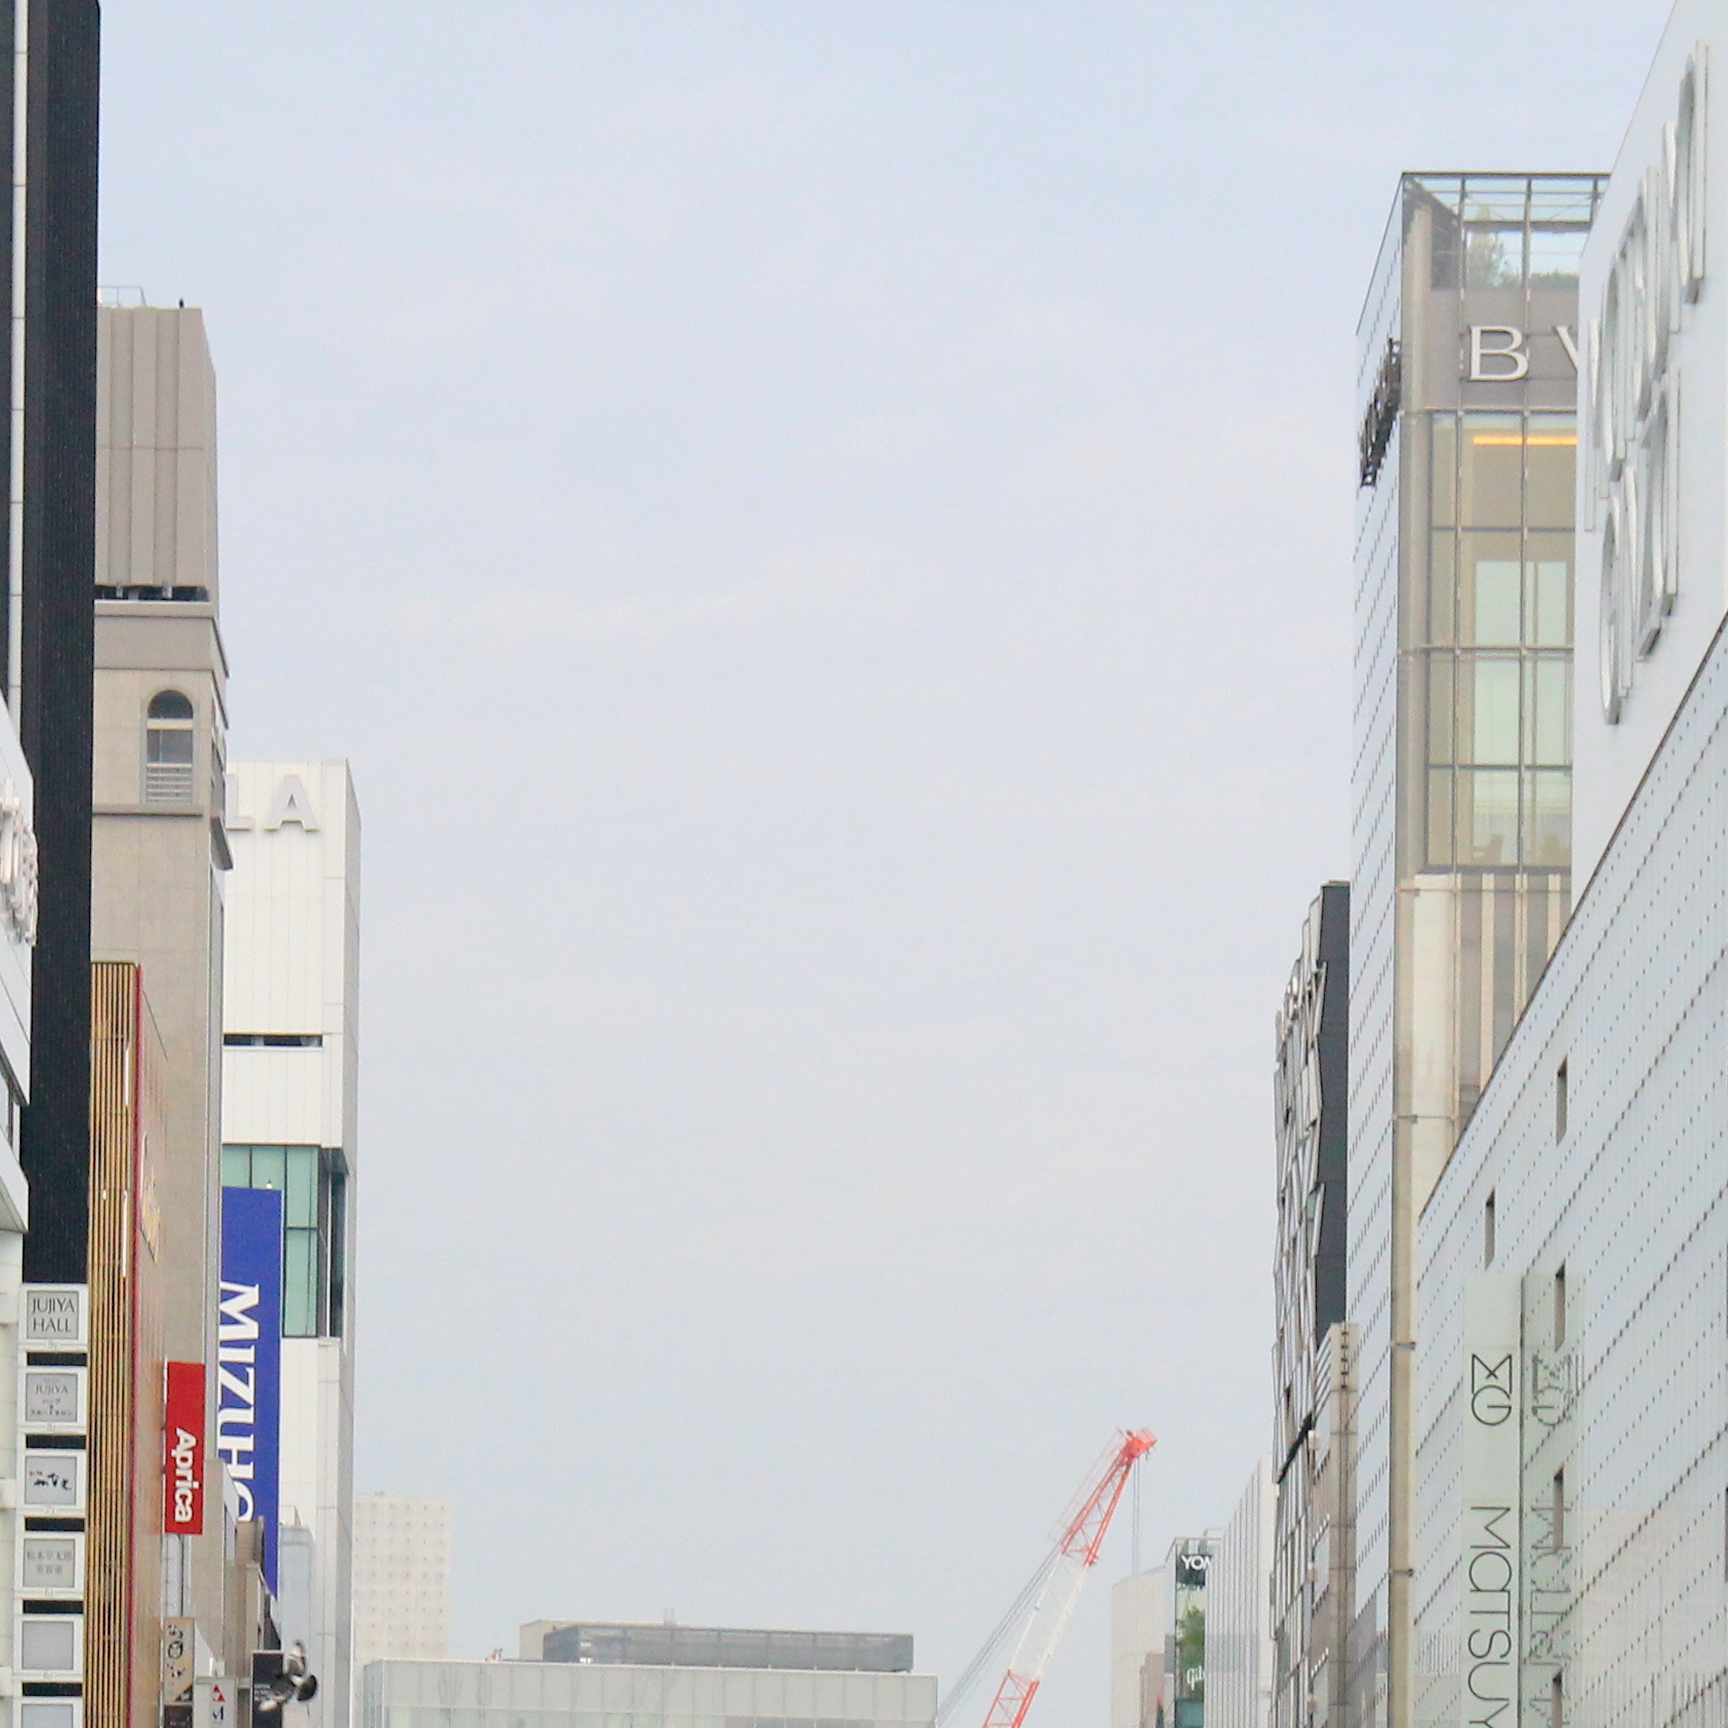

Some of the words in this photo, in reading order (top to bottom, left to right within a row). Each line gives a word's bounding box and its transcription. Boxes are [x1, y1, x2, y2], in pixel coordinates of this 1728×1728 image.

[31, 1298, 75, 1314] JUJIYA
[32, 1317, 72, 1333] HALL
[172, 1427, 193, 1524] Aprica
